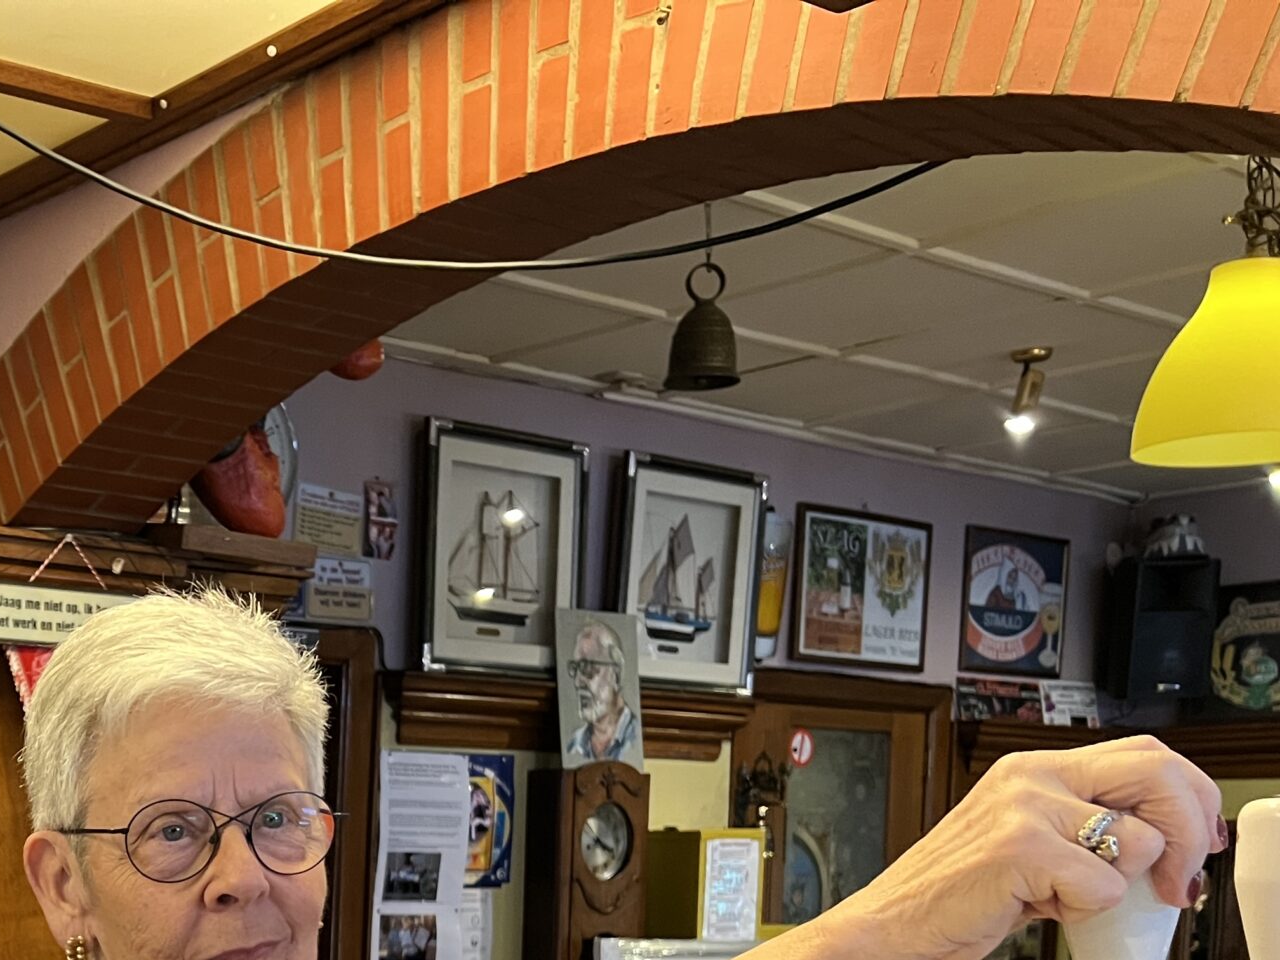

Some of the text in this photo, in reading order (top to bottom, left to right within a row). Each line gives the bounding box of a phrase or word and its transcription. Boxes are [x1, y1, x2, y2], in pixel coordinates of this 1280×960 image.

[25, 599, 41, 610] me
[44, 600, 63, 612] niet
[84, 604, 93, 614] ik
[12, 617, 37, 629] werk
[40, 620, 53, 630] en
[56, 621, 75, 633] niet
